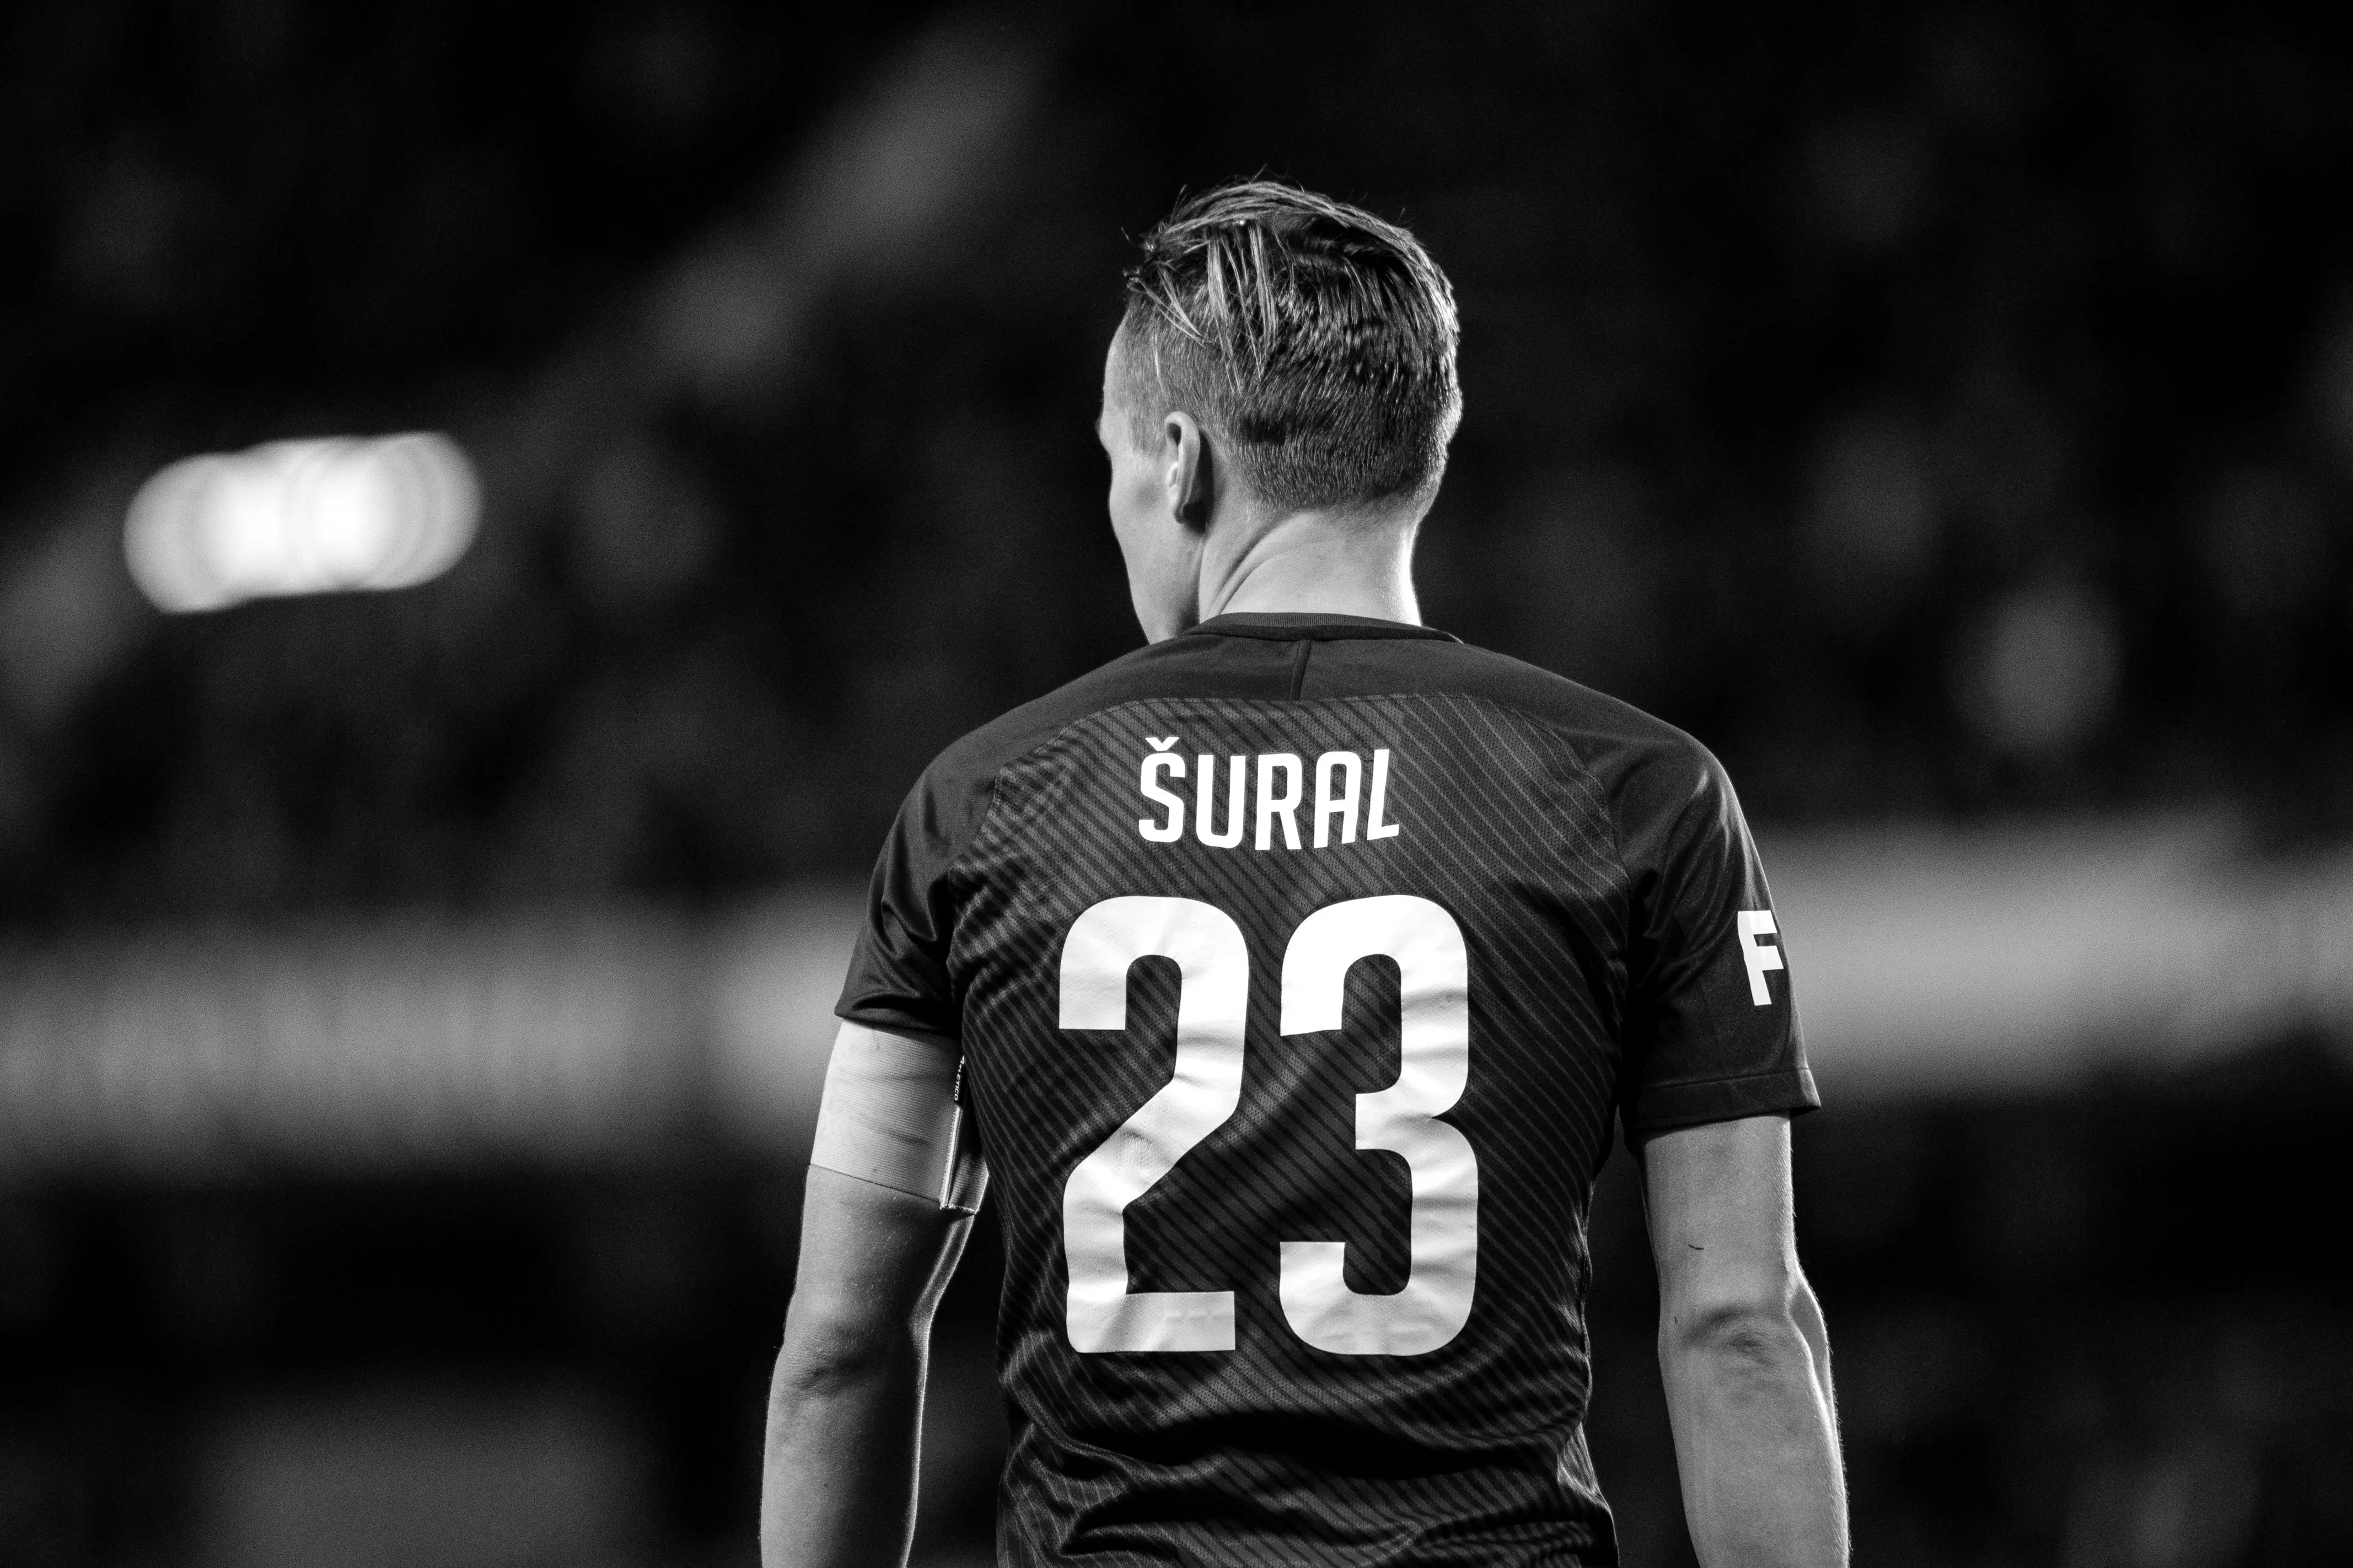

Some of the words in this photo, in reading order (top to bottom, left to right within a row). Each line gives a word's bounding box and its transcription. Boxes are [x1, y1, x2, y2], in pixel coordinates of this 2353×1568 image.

[1138, 736, 1400, 850] ŠURAL
[1737, 909, 1785, 1006] F
[1057, 894, 1480, 1357] 23
